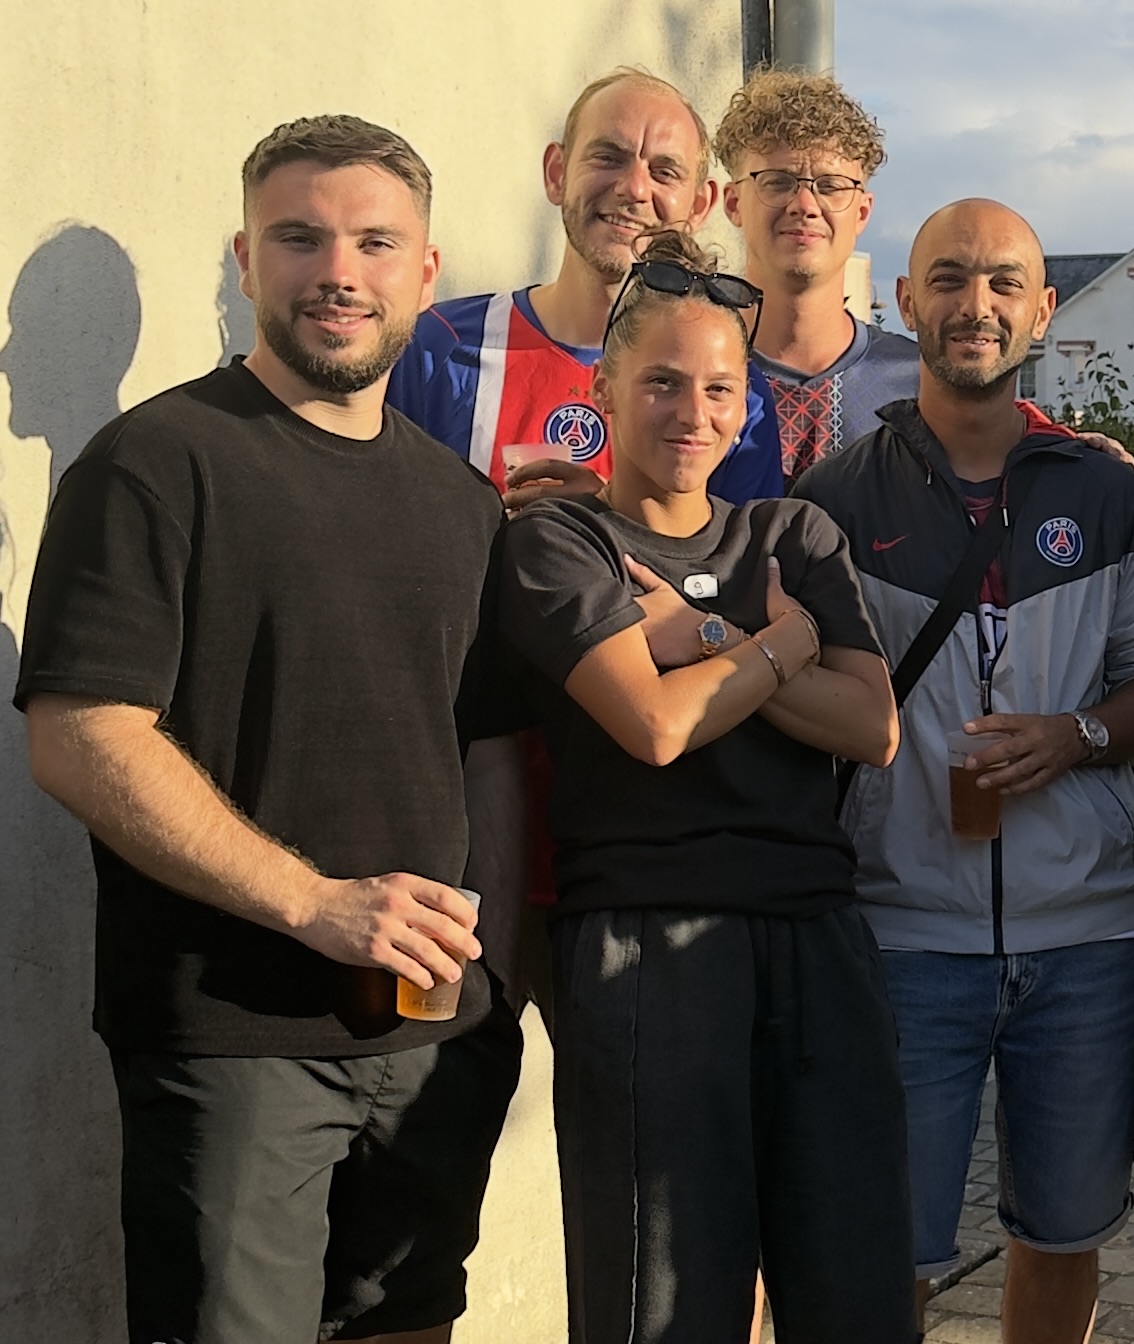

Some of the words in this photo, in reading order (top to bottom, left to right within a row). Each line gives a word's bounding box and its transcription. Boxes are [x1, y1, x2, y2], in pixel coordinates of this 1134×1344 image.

[558, 409, 597, 426] PARIS
[1045, 520, 1078, 534] PARIS
[694, 581, 704, 595] 9
